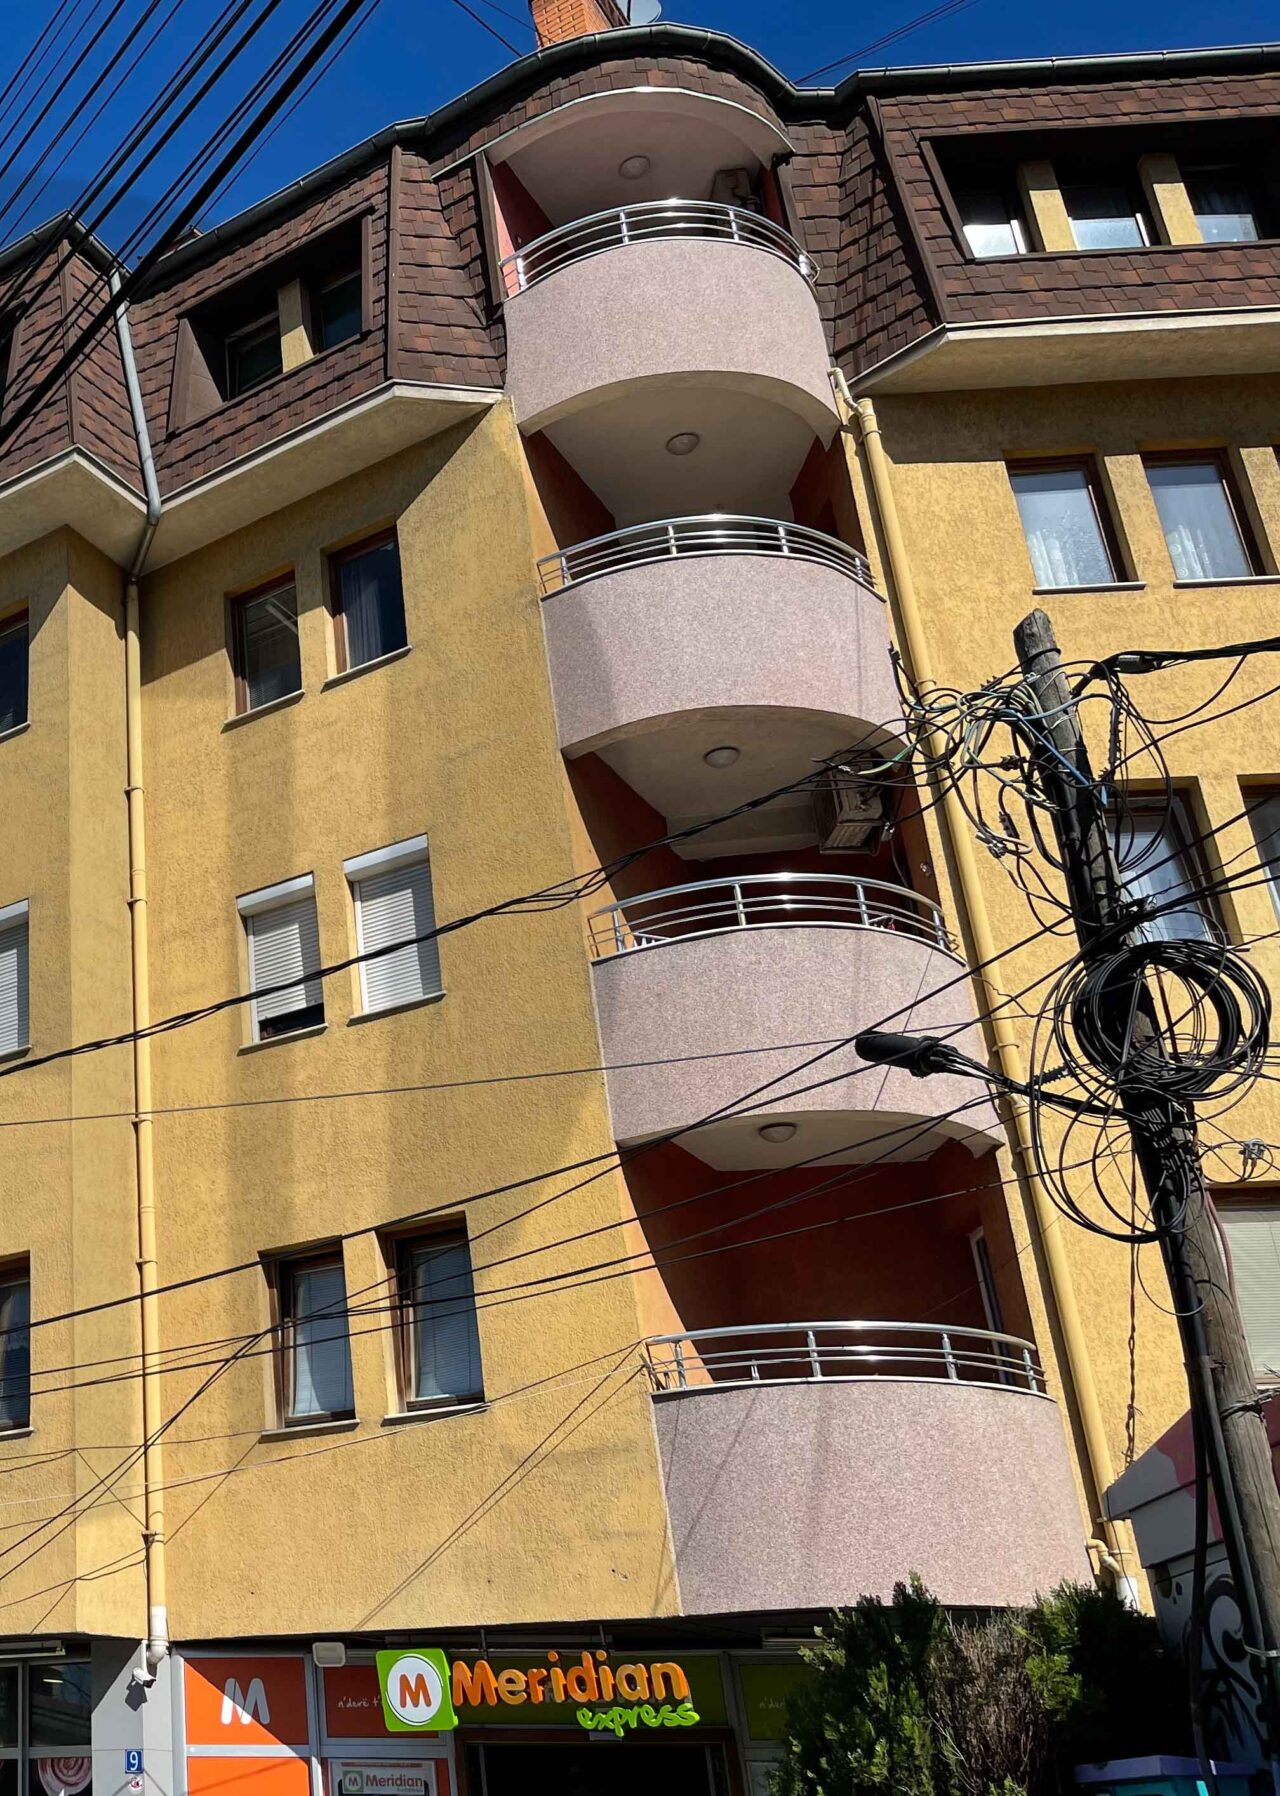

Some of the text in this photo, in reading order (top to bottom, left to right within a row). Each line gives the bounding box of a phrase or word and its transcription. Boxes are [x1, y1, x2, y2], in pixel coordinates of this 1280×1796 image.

[399, 1673, 432, 1708] M
[452, 1650, 689, 1707] Meridian
[221, 1678, 270, 1725] M
[576, 1703, 700, 1737] express
[129, 1752, 139, 1771] 9
[366, 1774, 423, 1787] Meridian
